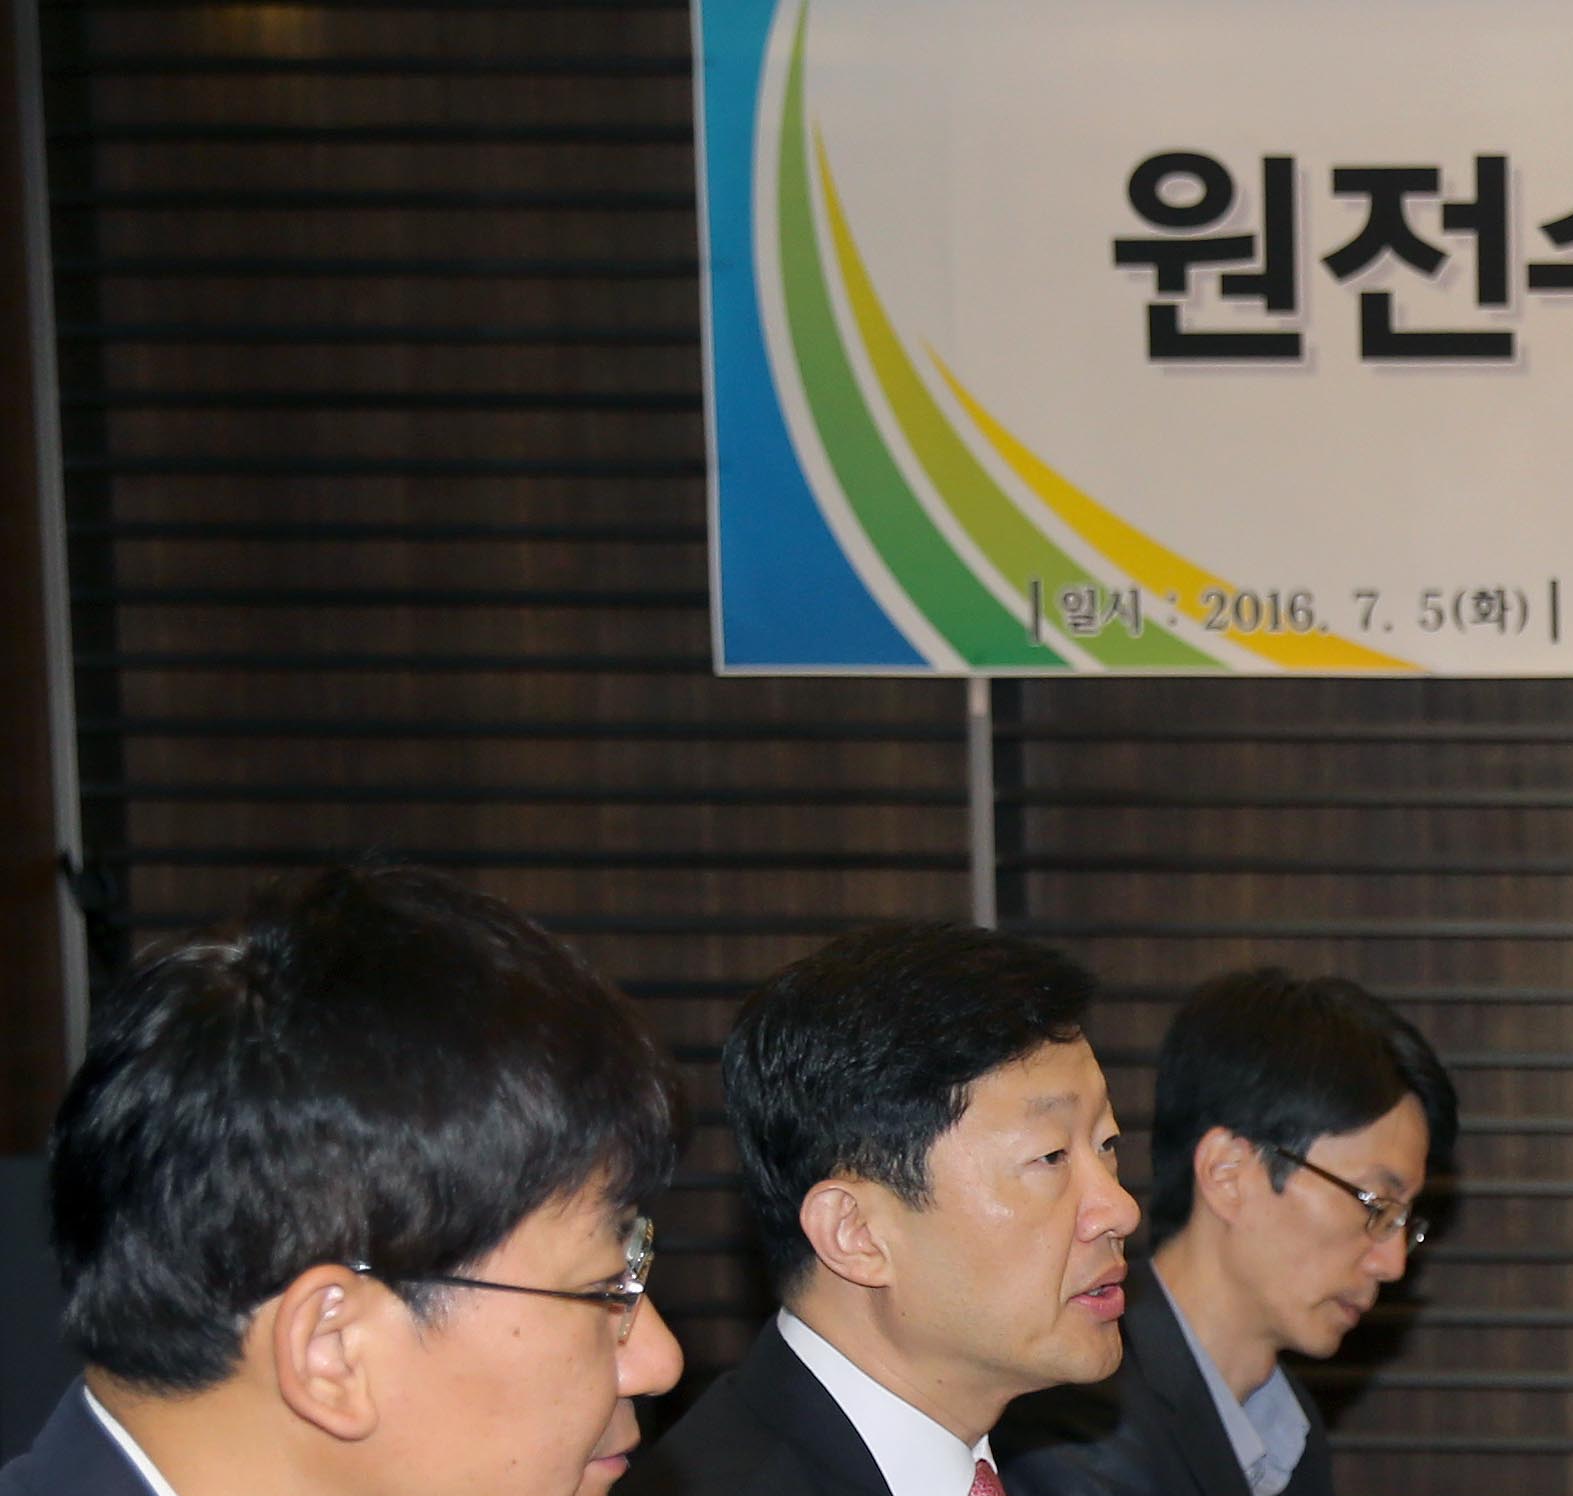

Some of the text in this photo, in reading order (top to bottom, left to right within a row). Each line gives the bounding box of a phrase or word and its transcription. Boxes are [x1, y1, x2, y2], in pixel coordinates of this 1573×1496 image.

[1062, 586, 1143, 635] 일시
[1201, 588, 1330, 633] 2016.
[1353, 590, 1394, 632] 7.
[1418, 587, 1530, 634] 5(화)
